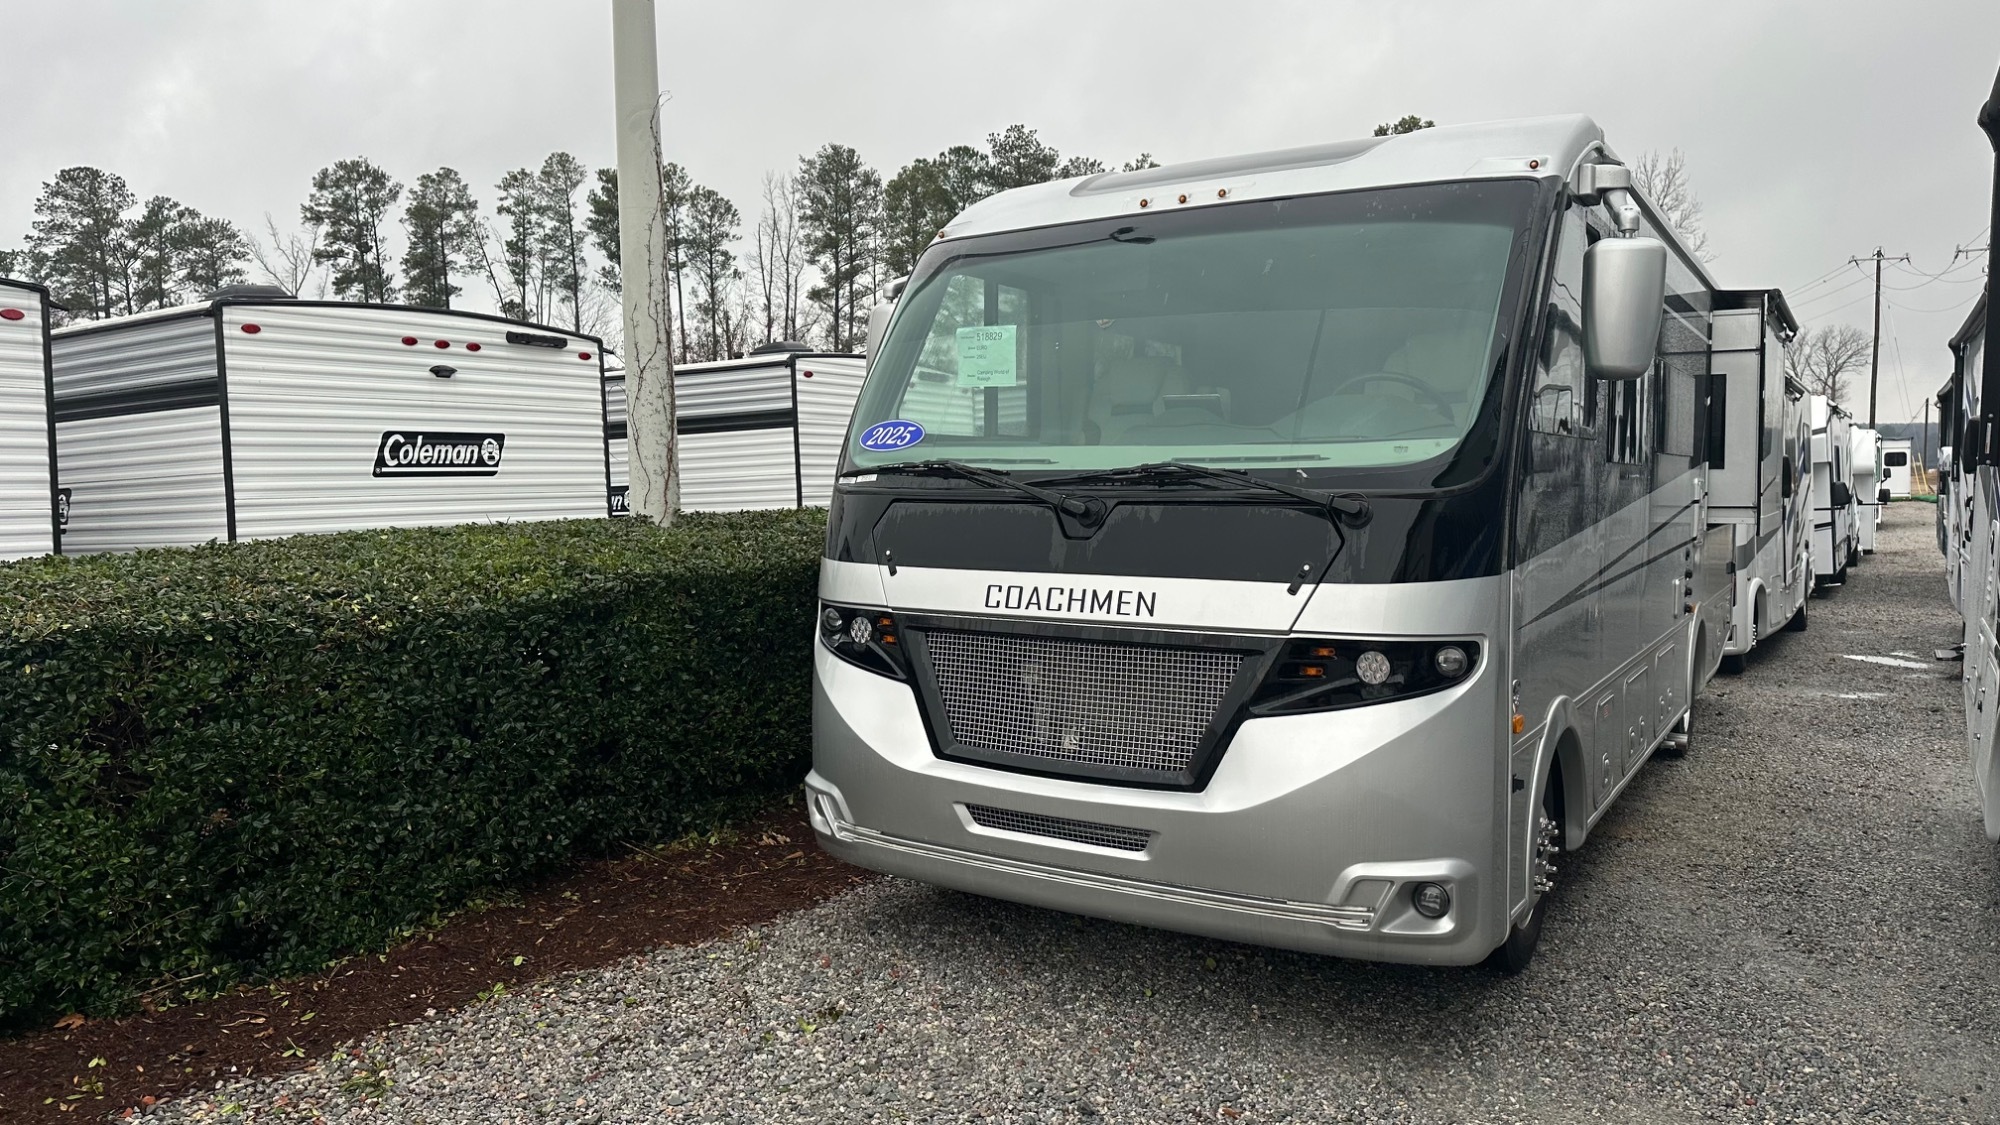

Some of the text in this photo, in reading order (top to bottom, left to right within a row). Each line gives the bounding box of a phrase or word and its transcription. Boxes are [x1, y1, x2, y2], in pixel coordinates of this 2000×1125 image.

[976, 331, 1003, 342] 518829
[865, 426, 917, 446] 2025
[383, 433, 480, 466] Coleman
[985, 584, 1157, 617] COACHMEN
